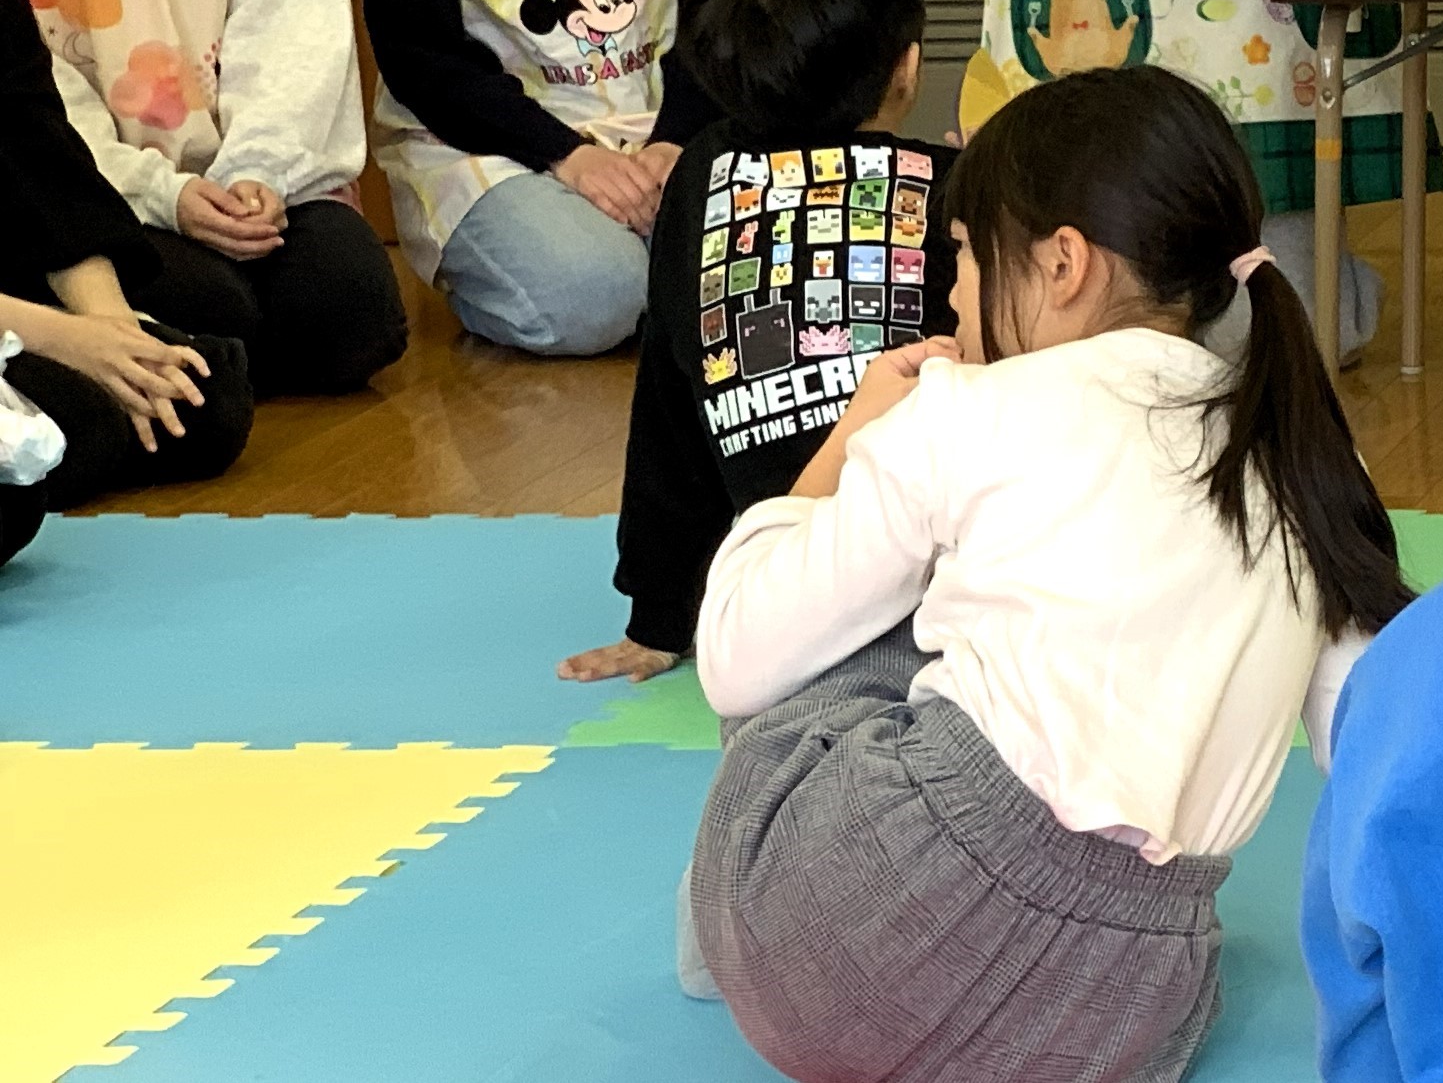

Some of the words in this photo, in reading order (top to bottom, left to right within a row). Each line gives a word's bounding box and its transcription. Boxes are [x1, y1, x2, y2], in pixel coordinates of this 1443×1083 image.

[574, 63, 599, 87] IS
[600, 56, 621, 80] A
[718, 414, 798, 459] CRAFTING
